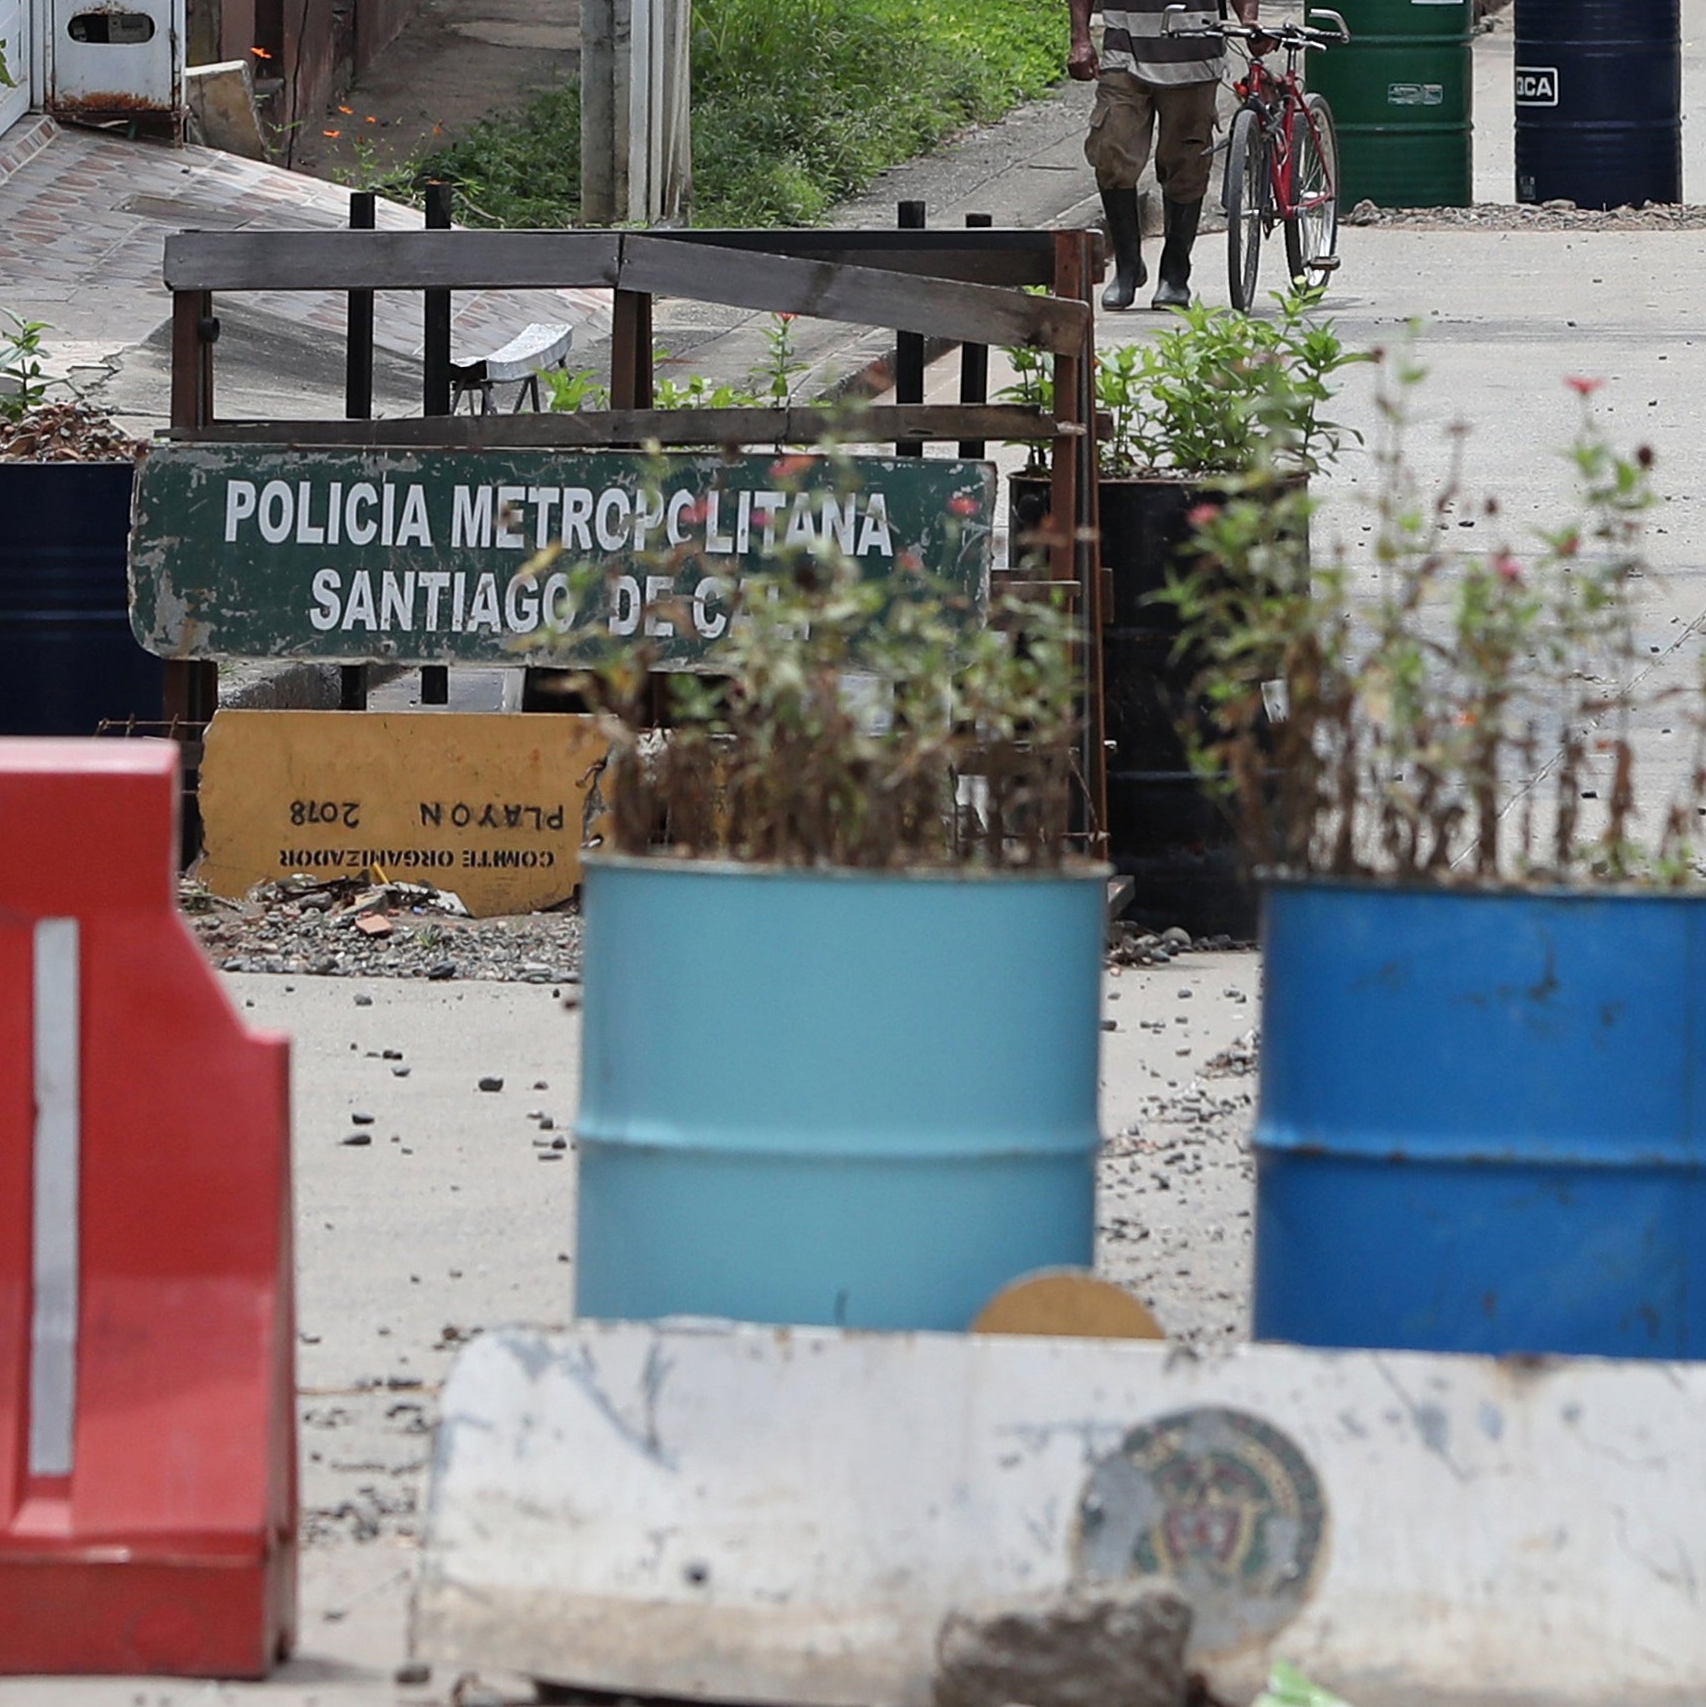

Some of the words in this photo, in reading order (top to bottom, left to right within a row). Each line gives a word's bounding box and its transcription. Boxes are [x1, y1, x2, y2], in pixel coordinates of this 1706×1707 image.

[224, 479, 432, 547] POLICIA
[451, 485, 893, 557] METROPOLITANA
[309, 568, 576, 634] SANTIAGO
[608, 575, 675, 637] DE
[420, 803, 564, 831] PLAYON
[279, 848, 454, 868] ORGANIZADOR
[462, 850, 555, 867] COMITE
